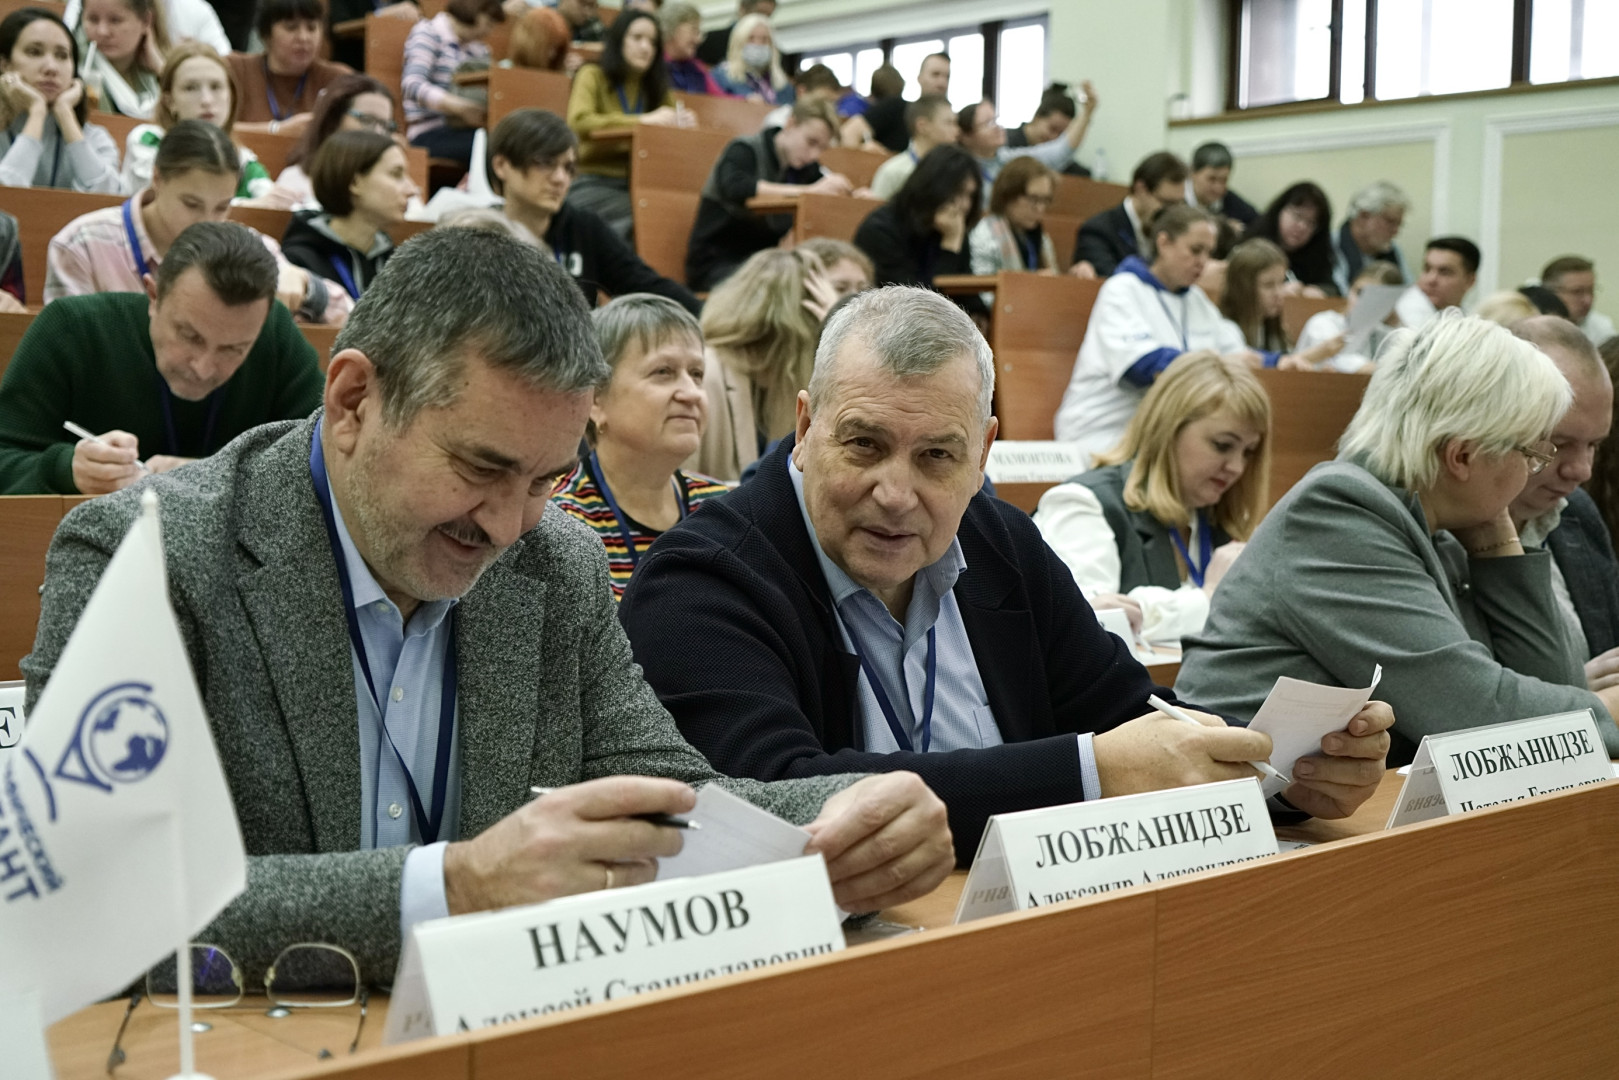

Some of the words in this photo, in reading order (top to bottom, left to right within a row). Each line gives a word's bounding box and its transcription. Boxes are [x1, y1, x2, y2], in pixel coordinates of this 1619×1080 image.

[1449, 729, 1594, 782] ЛОБЖАНИДЗЕ
[1035, 803, 1251, 869] ЛОБЖАНИДЗЕ
[526, 888, 751, 970] НАУМОВ
